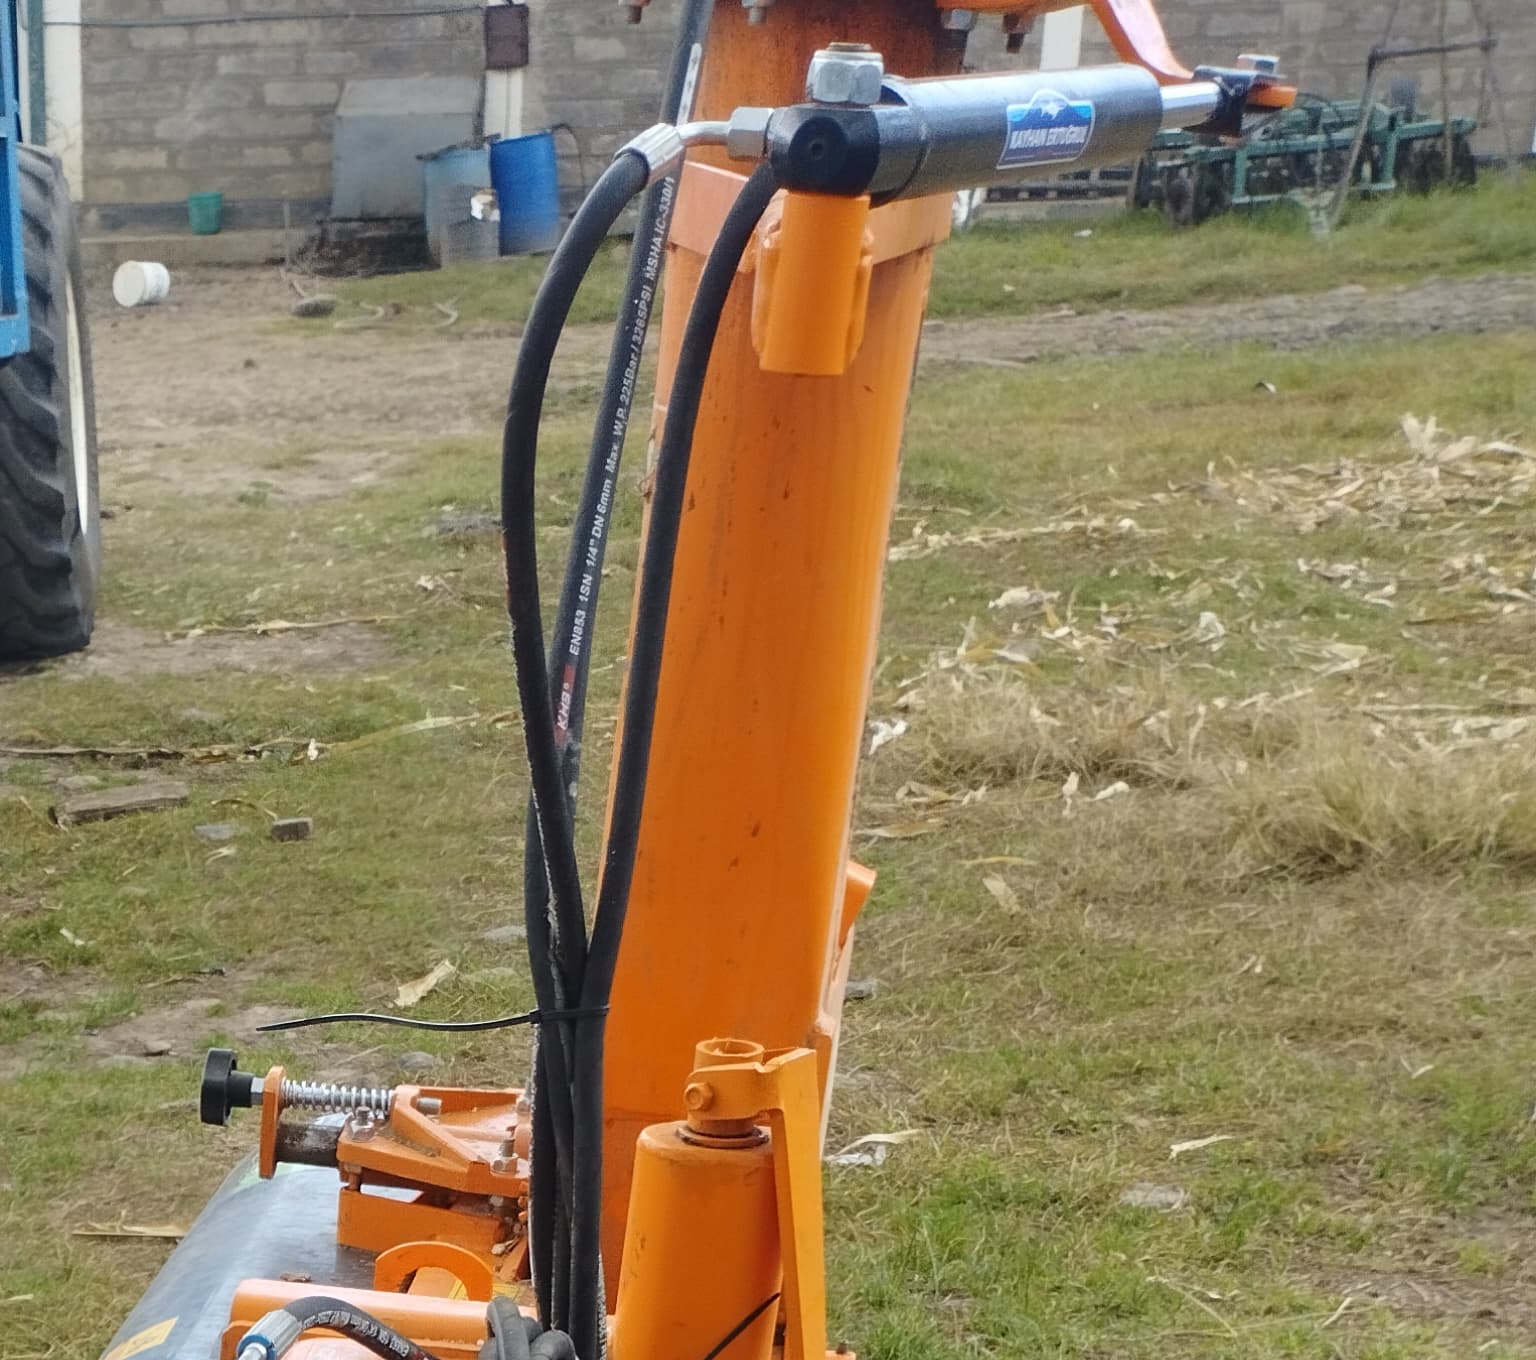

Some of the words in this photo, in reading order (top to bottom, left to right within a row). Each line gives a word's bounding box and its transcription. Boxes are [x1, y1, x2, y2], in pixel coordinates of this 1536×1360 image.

[653, 176, 675, 237] IC-330/1
[644, 237, 663, 281] MSHA
[619, 353, 639, 405] 225Bar
[596, 479, 613, 515] 6mm
[591, 513, 606, 539] DN
[578, 573, 594, 603] 1SN
[569, 609, 586, 656] EN853
